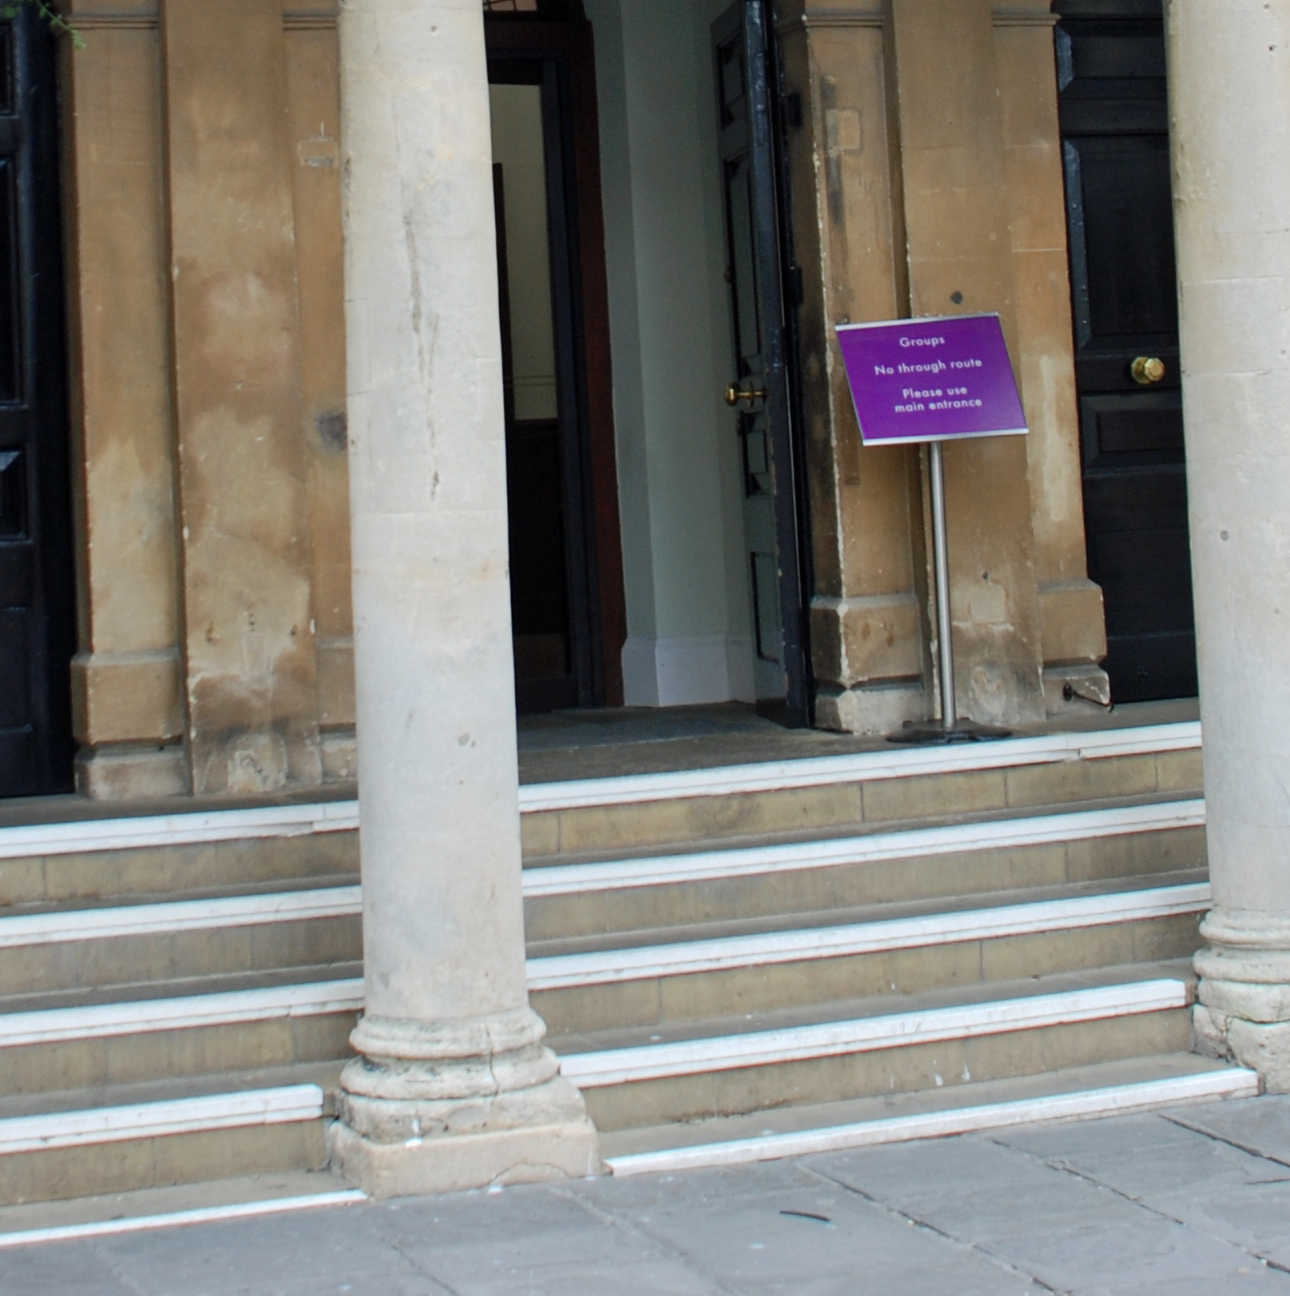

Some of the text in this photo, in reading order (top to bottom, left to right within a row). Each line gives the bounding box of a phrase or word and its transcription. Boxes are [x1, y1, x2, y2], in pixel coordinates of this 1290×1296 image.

[899, 336, 945, 348] Groups
[874, 358, 983, 376] No through route
[902, 386, 968, 399] Please use
[894, 397, 983, 413] main entrance
